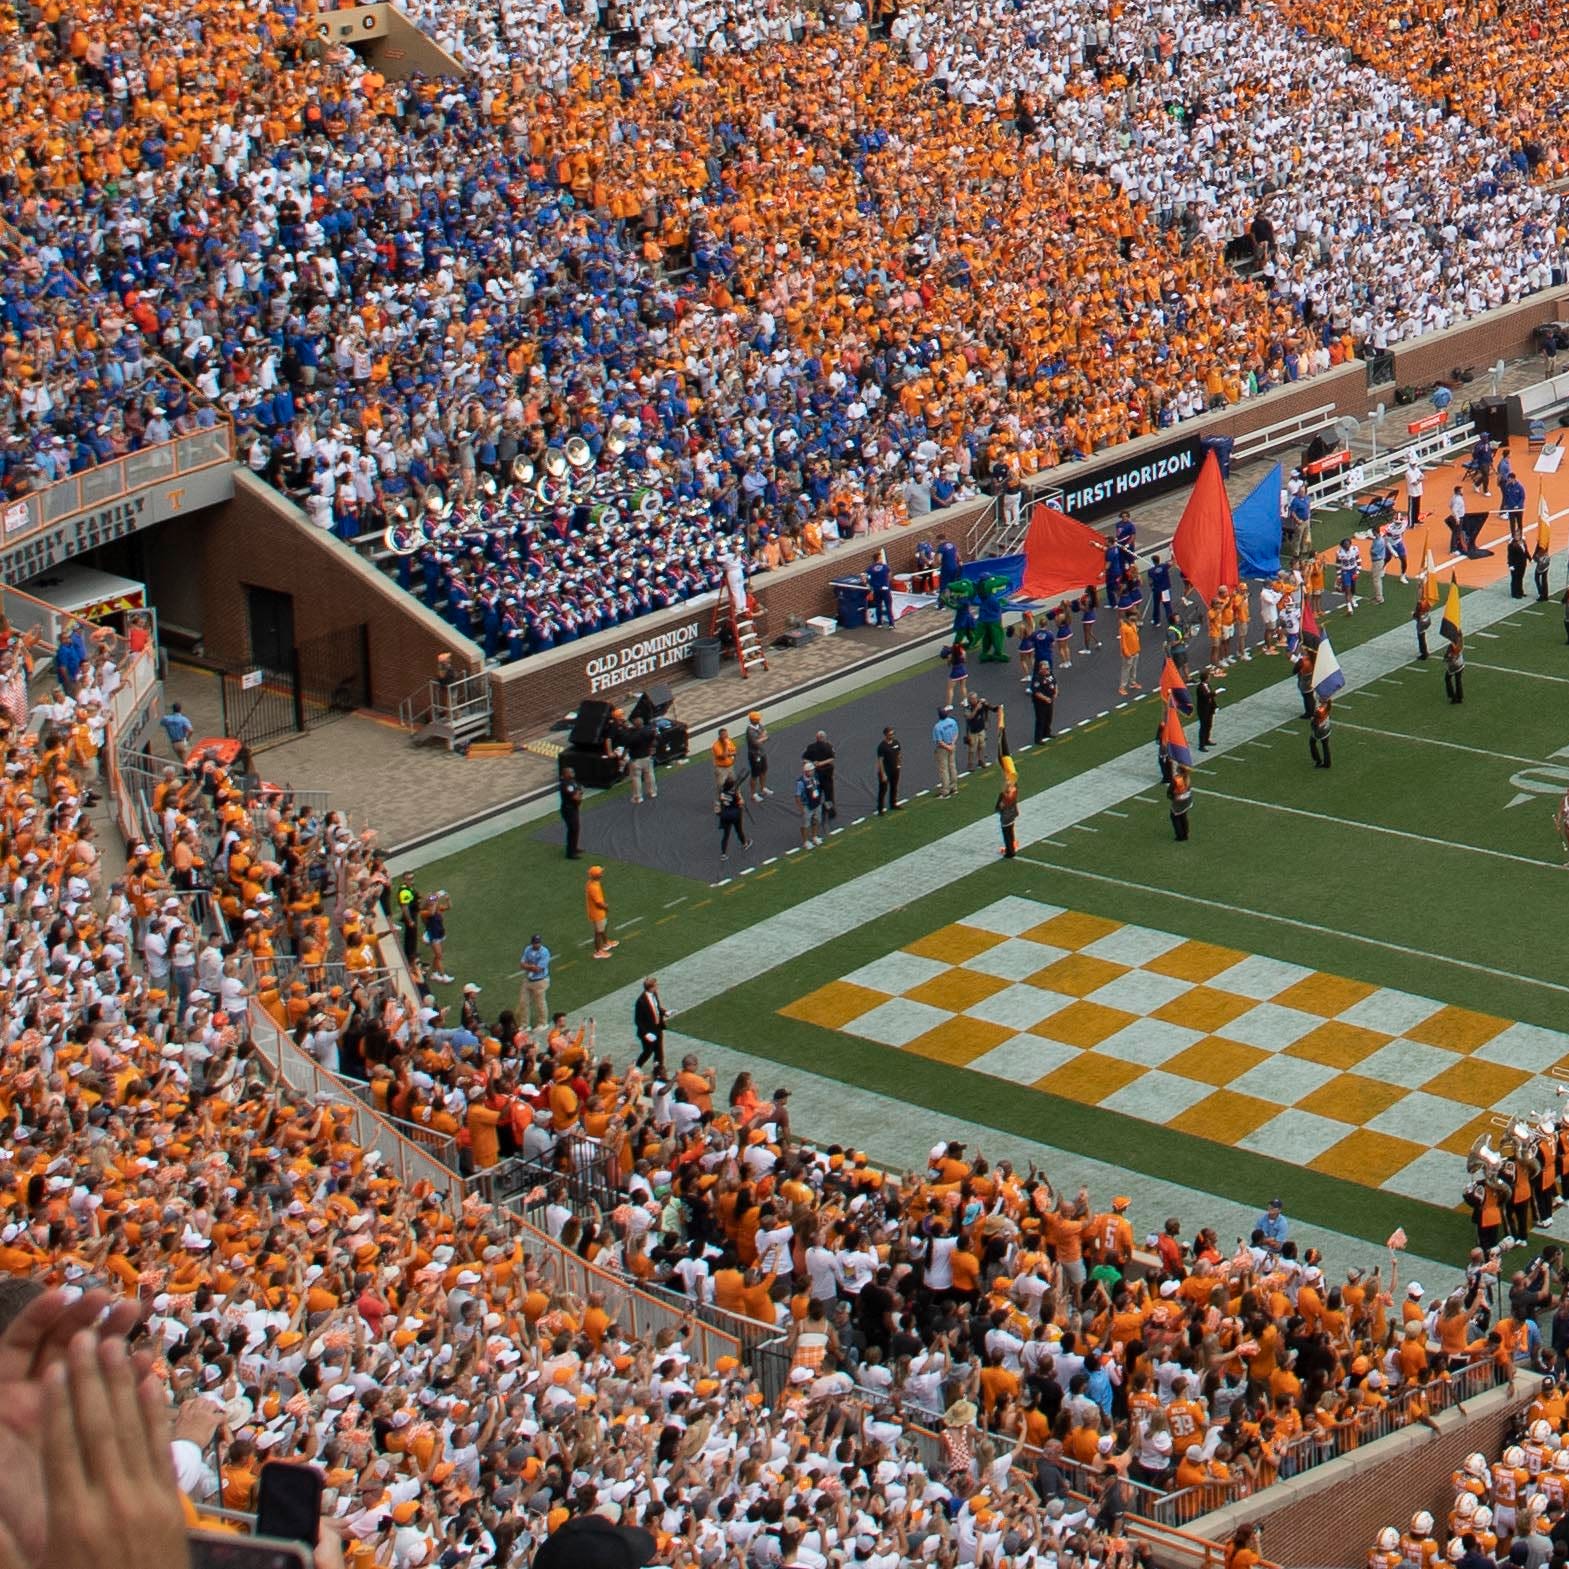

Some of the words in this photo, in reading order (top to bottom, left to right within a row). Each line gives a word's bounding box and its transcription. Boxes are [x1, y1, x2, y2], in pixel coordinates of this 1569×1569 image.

[1066, 480, 1114, 513] FIRST
[1116, 450, 1192, 492] HORIZON
[586, 653, 618, 677] OLD
[620, 623, 699, 665] DOMINION
[591, 655, 657, 693] FREIGHT
[659, 643, 693, 668] LINE
